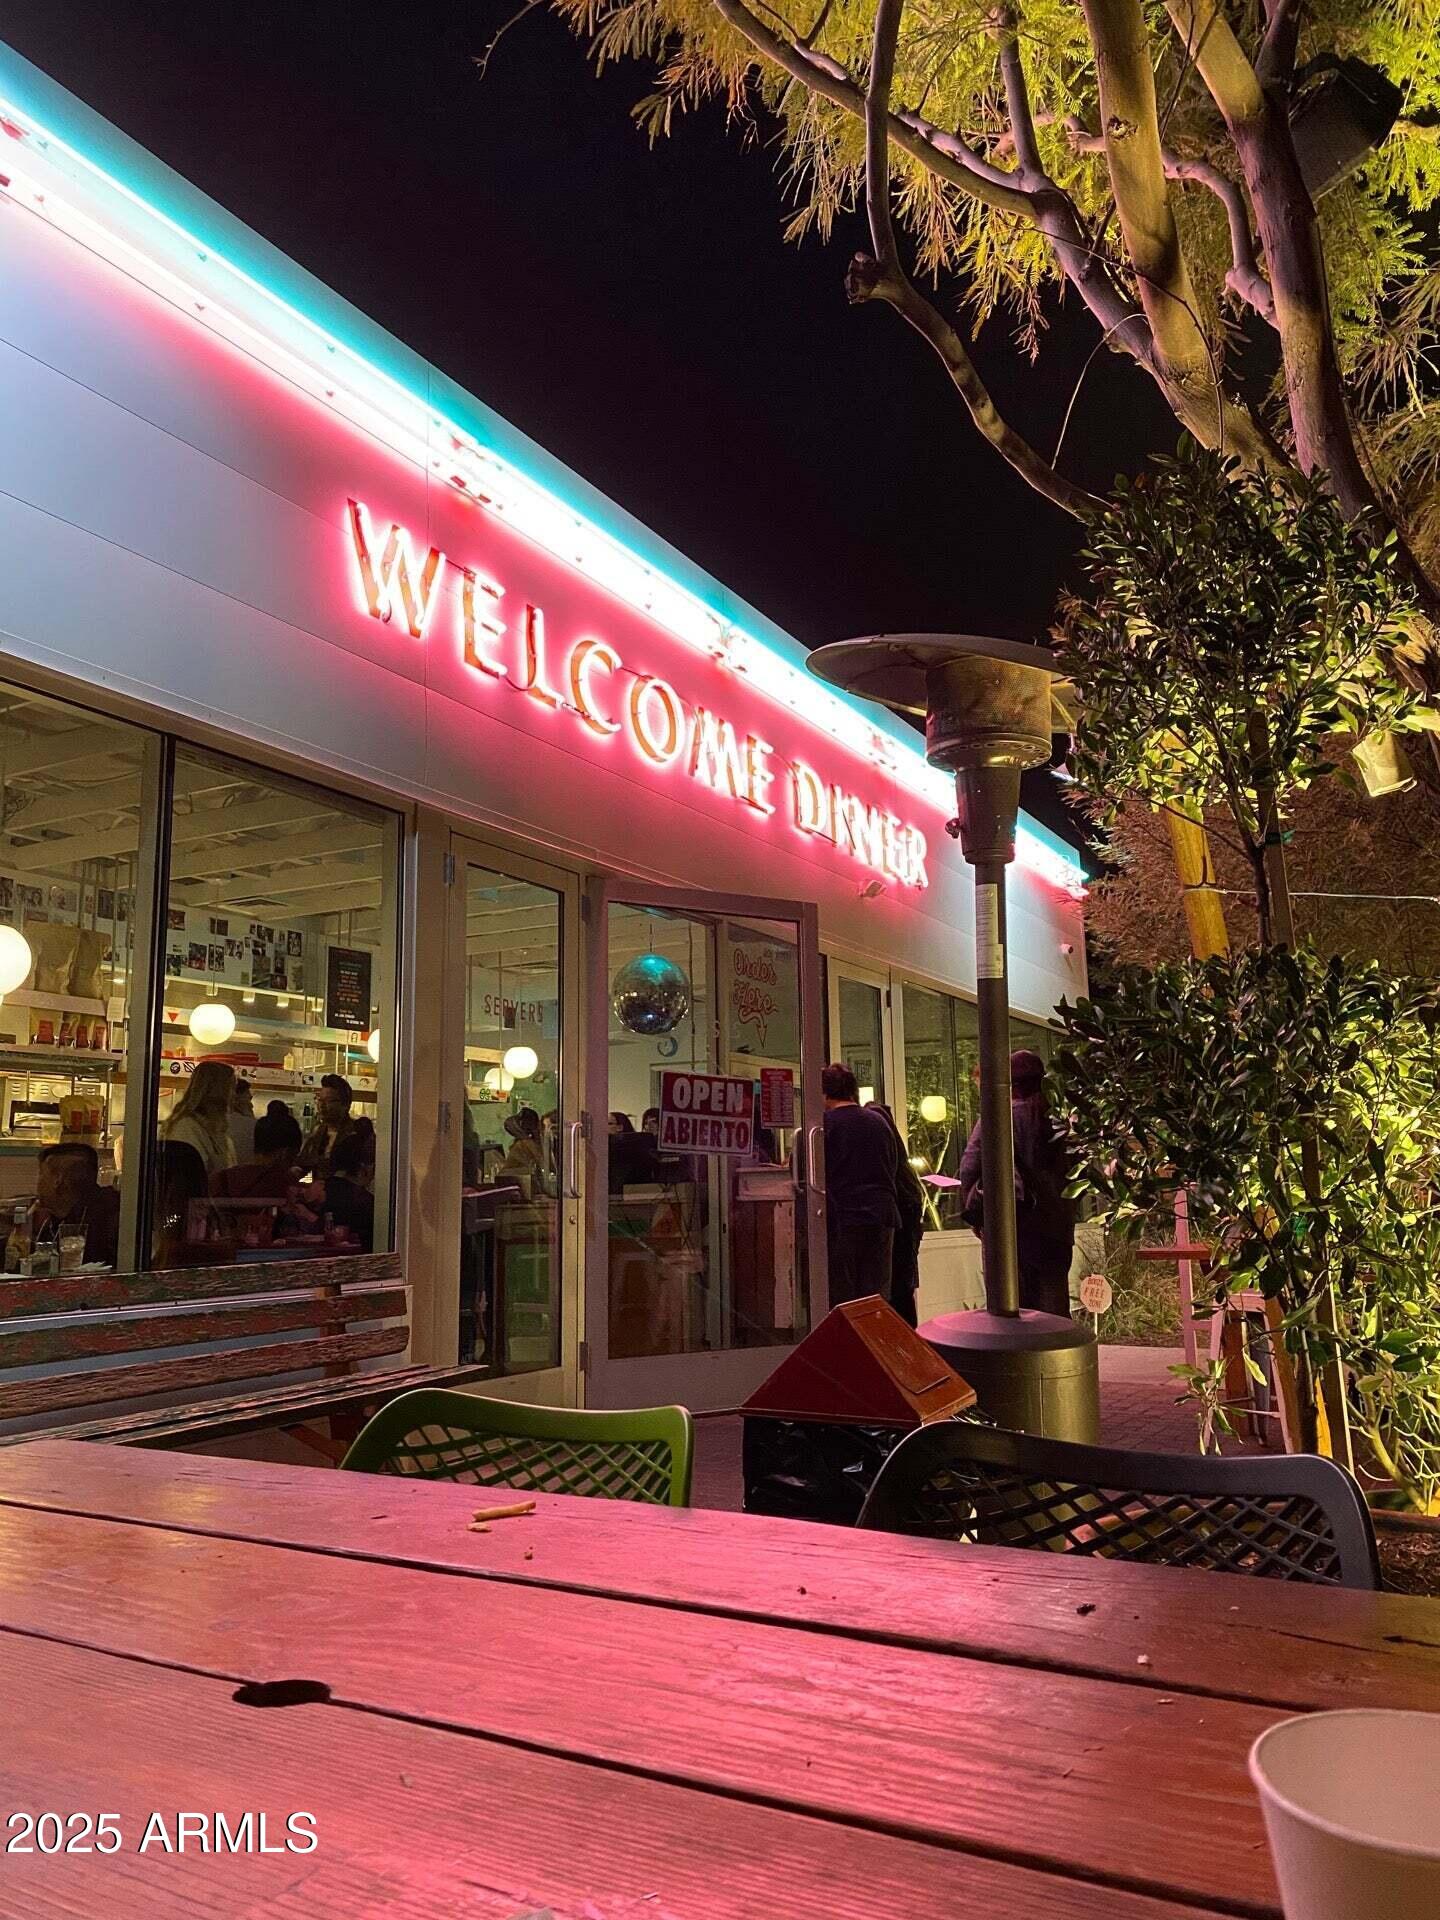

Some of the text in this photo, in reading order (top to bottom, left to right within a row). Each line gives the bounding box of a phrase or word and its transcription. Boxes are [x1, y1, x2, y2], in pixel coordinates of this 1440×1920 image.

[346, 496, 929, 889] WELCOME DINER
[672, 1077, 744, 1113] OPEN
[663, 1116, 750, 1150] ABIERTO
[1083, 1287, 1104, 1299] FREE
